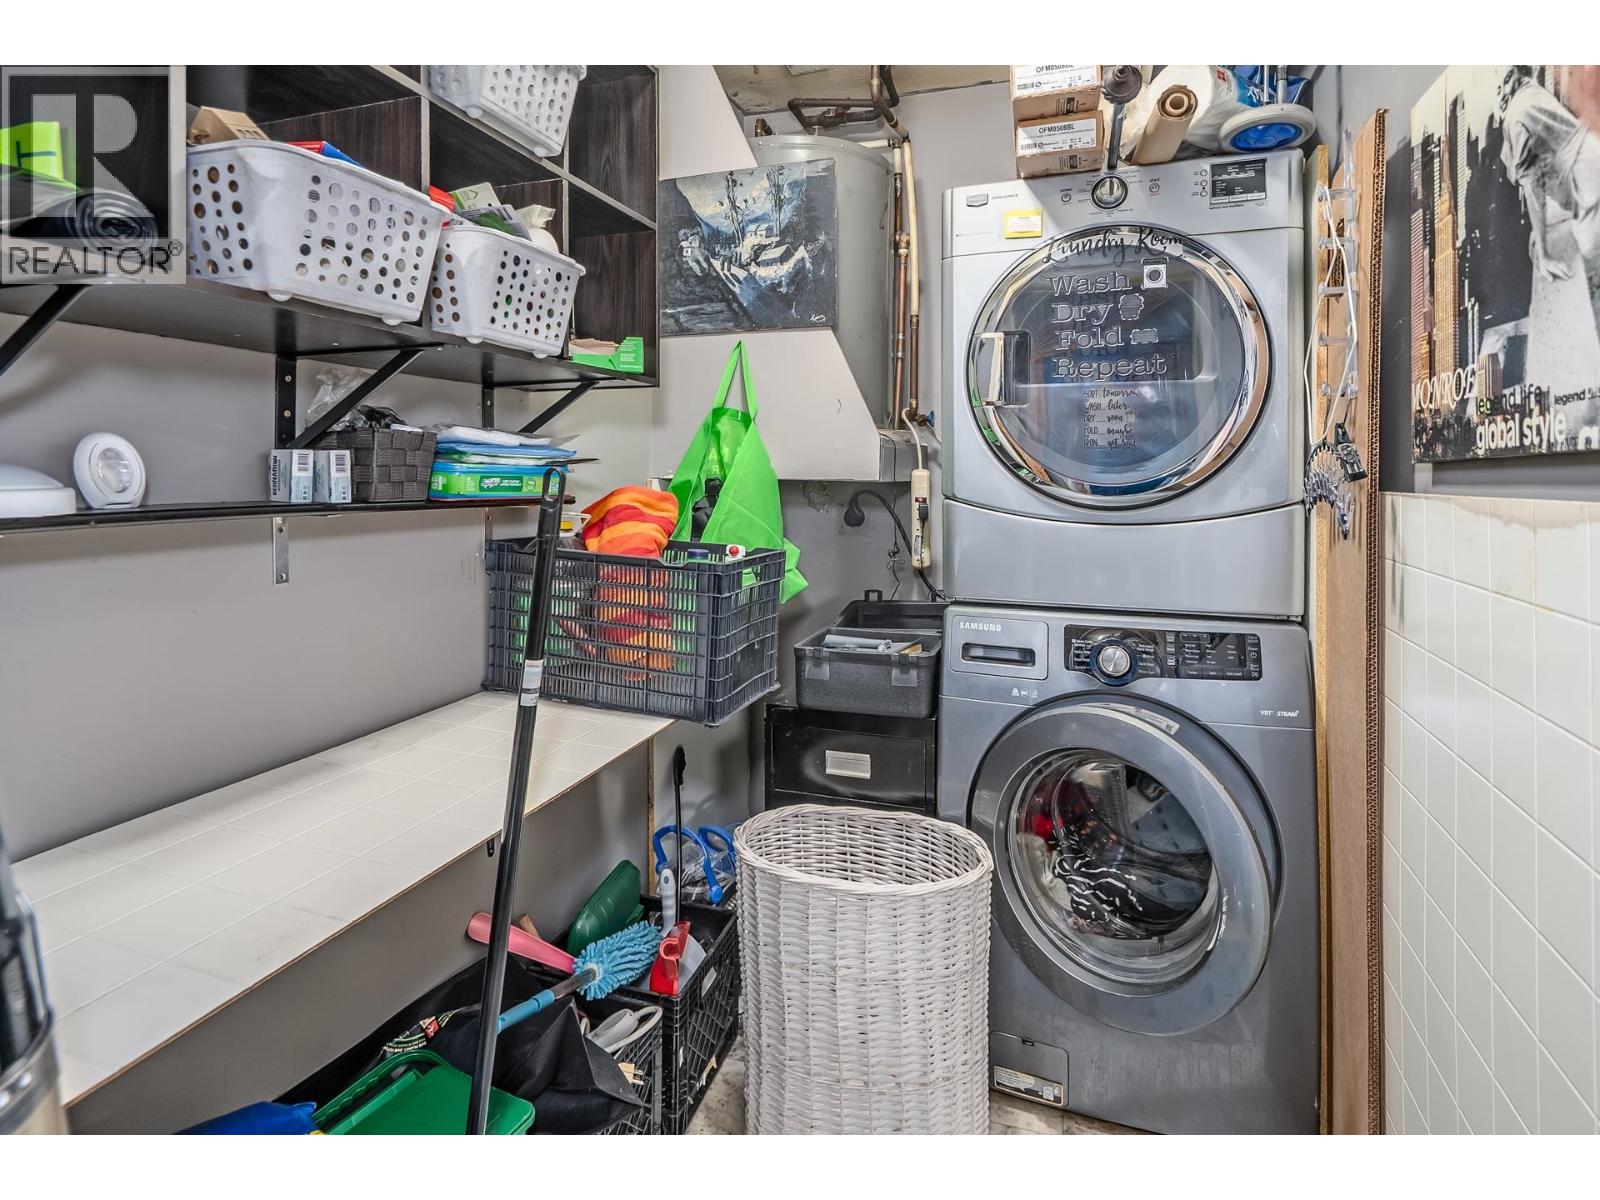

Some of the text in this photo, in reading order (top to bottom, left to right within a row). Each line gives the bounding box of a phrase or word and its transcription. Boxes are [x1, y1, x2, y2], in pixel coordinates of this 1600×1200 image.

[1047, 271, 1133, 297] Wash
[1051, 302, 1114, 325] Dry
[1055, 325, 1125, 350] Fold
[1052, 353, 1167, 381] Repeat
[1553, 388, 1586, 406] legend
[1476, 412, 1520, 457] global
[1522, 406, 1567, 454] style
[959, 621, 1002, 632] SAMSUNG
